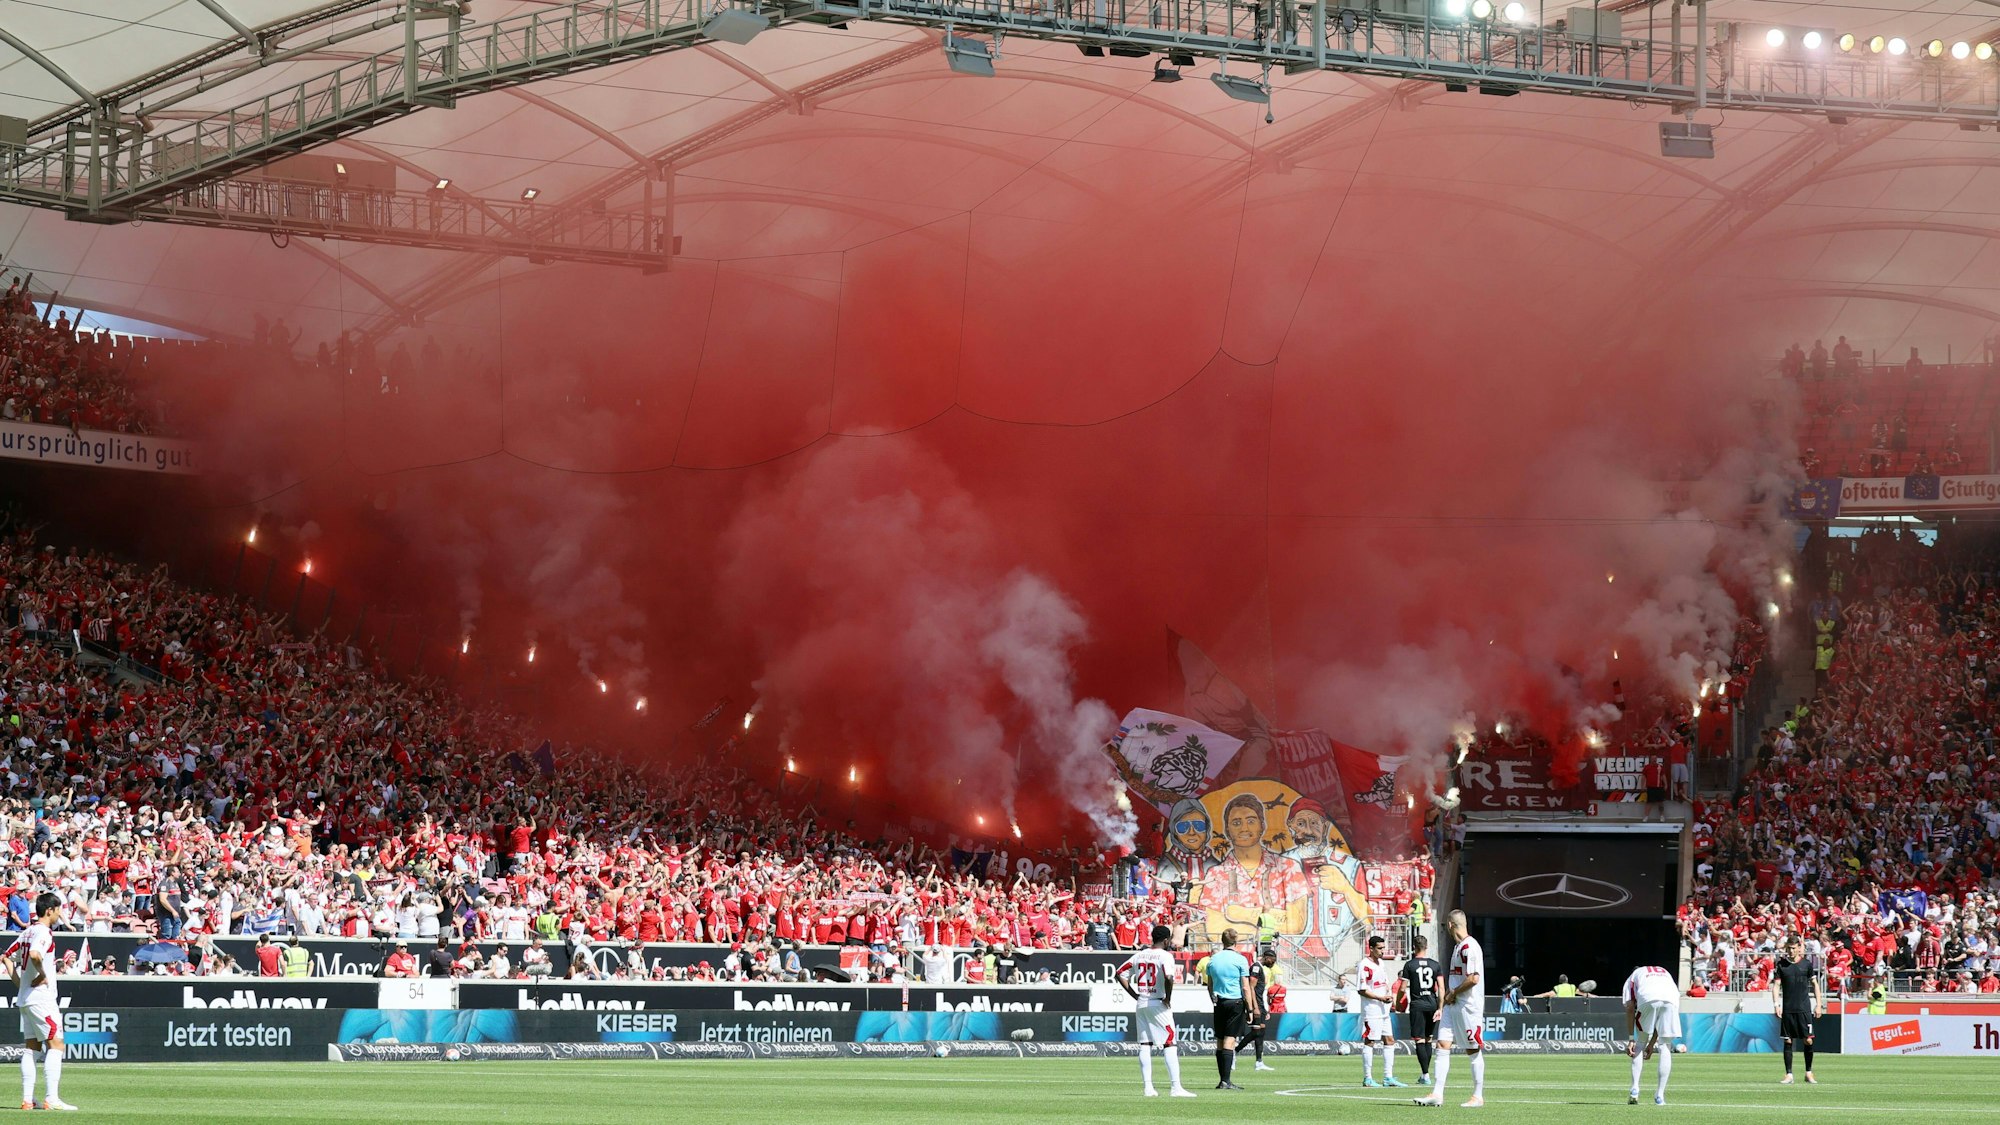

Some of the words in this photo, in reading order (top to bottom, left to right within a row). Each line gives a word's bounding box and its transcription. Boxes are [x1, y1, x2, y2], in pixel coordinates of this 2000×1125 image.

[2, 432, 147, 464] ursprünglich
[1842, 481, 1900, 502] ofbräu
[1481, 795, 1564, 808] CREW
[1588, 804, 1596, 815] 4
[1138, 962, 1157, 986] 23
[1416, 966, 1433, 989] 13
[409, 983, 424, 1000] 54
[1112, 987, 1125, 1003] 55
[597, 1014, 678, 1033] KIESER
[698, 1021, 742, 1043] Jetzt
[746, 1021, 833, 1043] trainieren
[1061, 1015, 1129, 1033] KIESER
[1520, 1023, 1553, 1042] Jetzt
[1553, 1021, 1614, 1042] trainieren
[164, 1021, 218, 1048] Jetzt
[222, 1022, 292, 1047] testen
